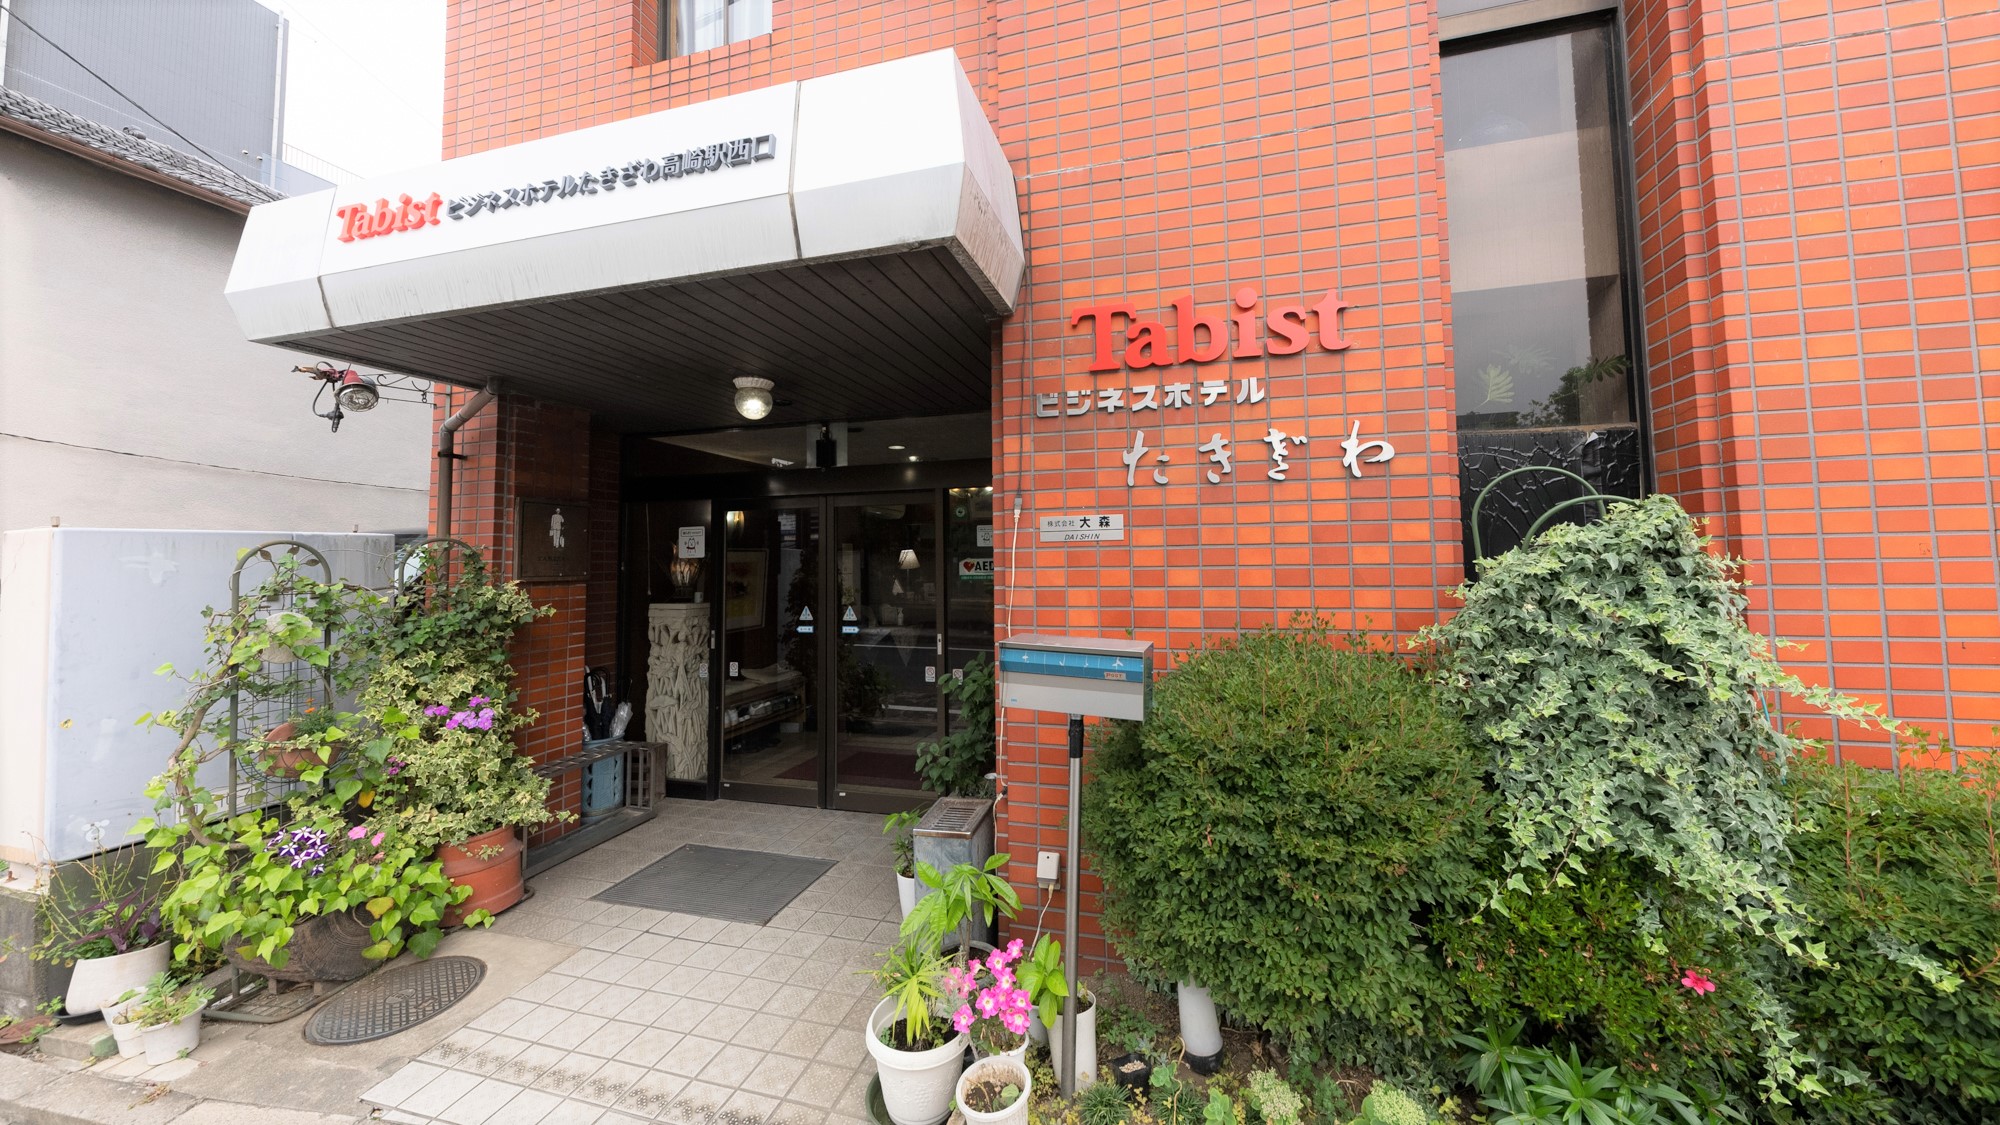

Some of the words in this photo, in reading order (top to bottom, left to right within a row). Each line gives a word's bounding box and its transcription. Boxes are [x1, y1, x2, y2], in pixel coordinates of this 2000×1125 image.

[336, 192, 443, 243] Tabist
[446, 133, 777, 220] ビジネスホテルたきざわ高崎駅西口
[1071, 287, 1351, 373] Tabist
[1036, 377, 1265, 418] ビジネスホテル
[1047, 519, 1076, 528] 株式会社
[1063, 533, 1101, 541] DAISHIN
